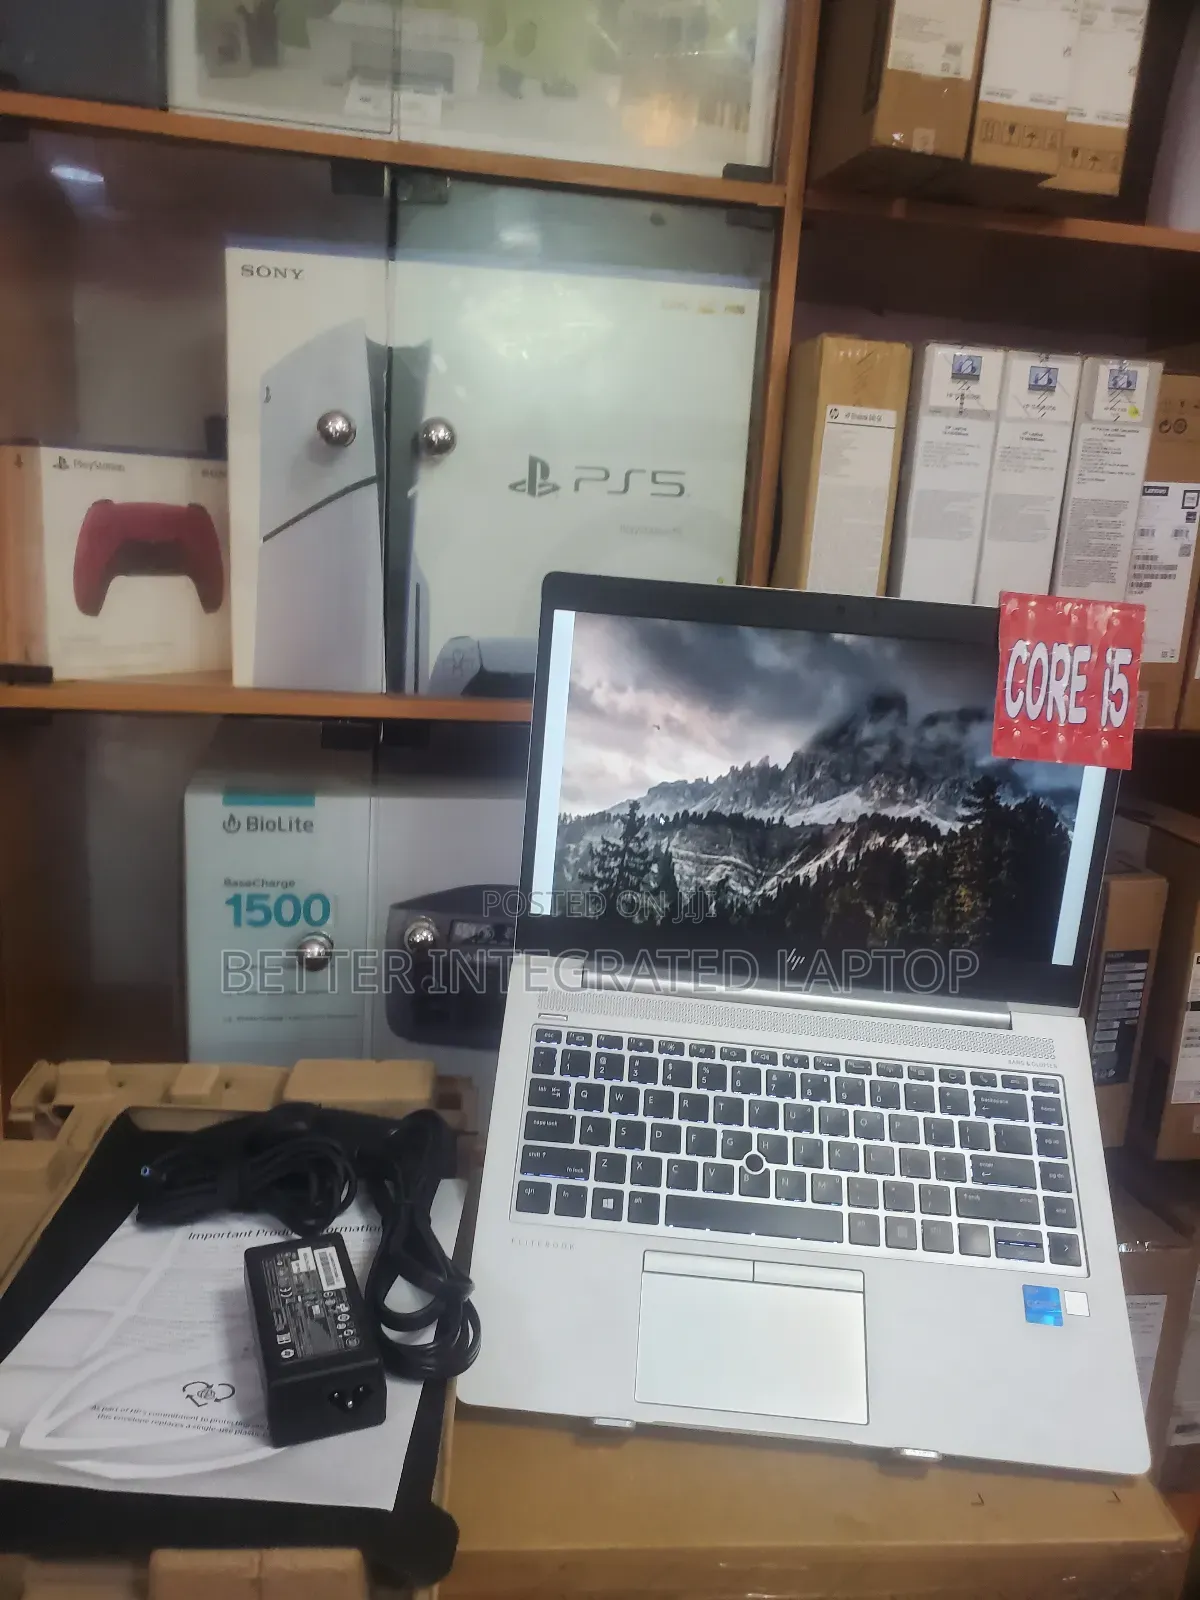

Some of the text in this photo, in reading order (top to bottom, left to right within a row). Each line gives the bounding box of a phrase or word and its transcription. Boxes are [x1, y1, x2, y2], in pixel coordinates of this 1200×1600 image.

[240, 264, 304, 280] SONY
[573, 465, 686, 498] PS5
[1005, 639, 1092, 725] CORE
[246, 815, 314, 833] BioLite
[223, 877, 296, 889] BaseCharge
[225, 892, 331, 928] 1500
[188, 1229, 252, 1241] Important
